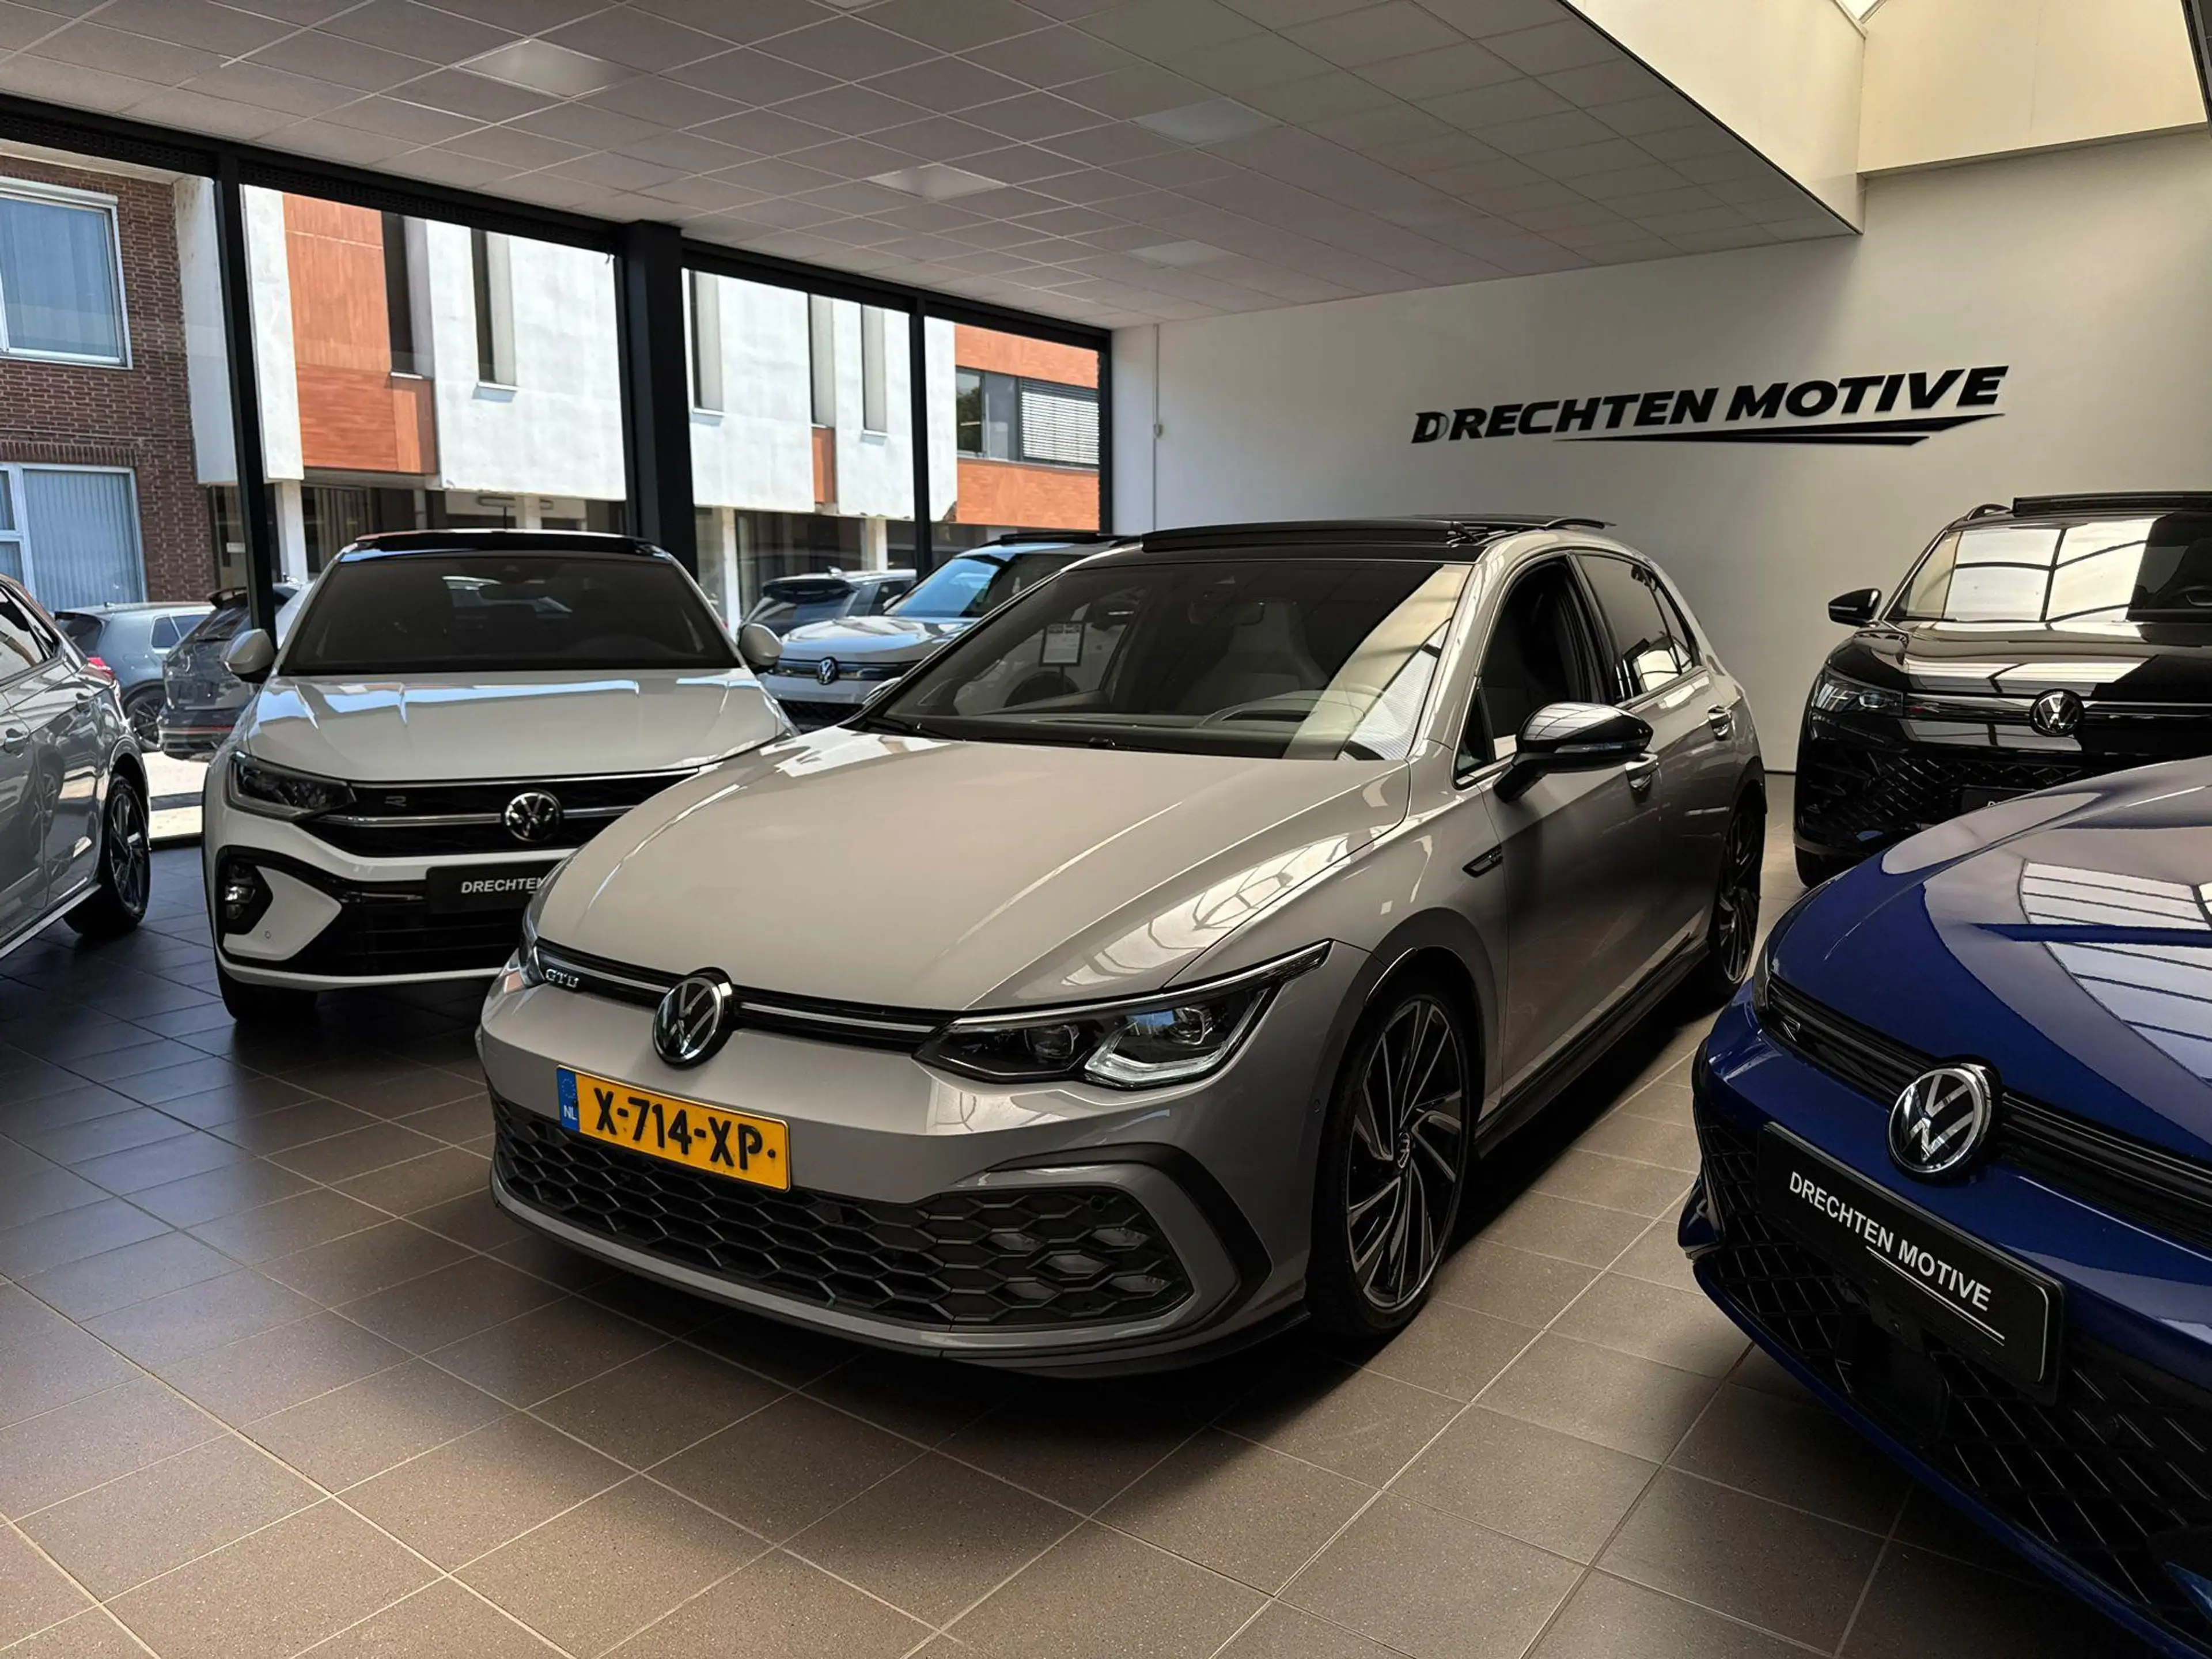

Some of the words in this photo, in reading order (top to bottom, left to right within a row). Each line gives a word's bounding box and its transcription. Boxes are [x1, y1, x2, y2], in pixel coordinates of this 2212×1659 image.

[1411, 388, 1719, 444] DRECHTEN
[1725, 365, 2009, 422] MOTIVE
[563, 1104, 578, 1120] NL
[593, 1087, 763, 1171] X-714-XP
[1789, 1172, 1894, 1253] DRECHTEN
[1898, 1239, 1991, 1312] MOTIVE
